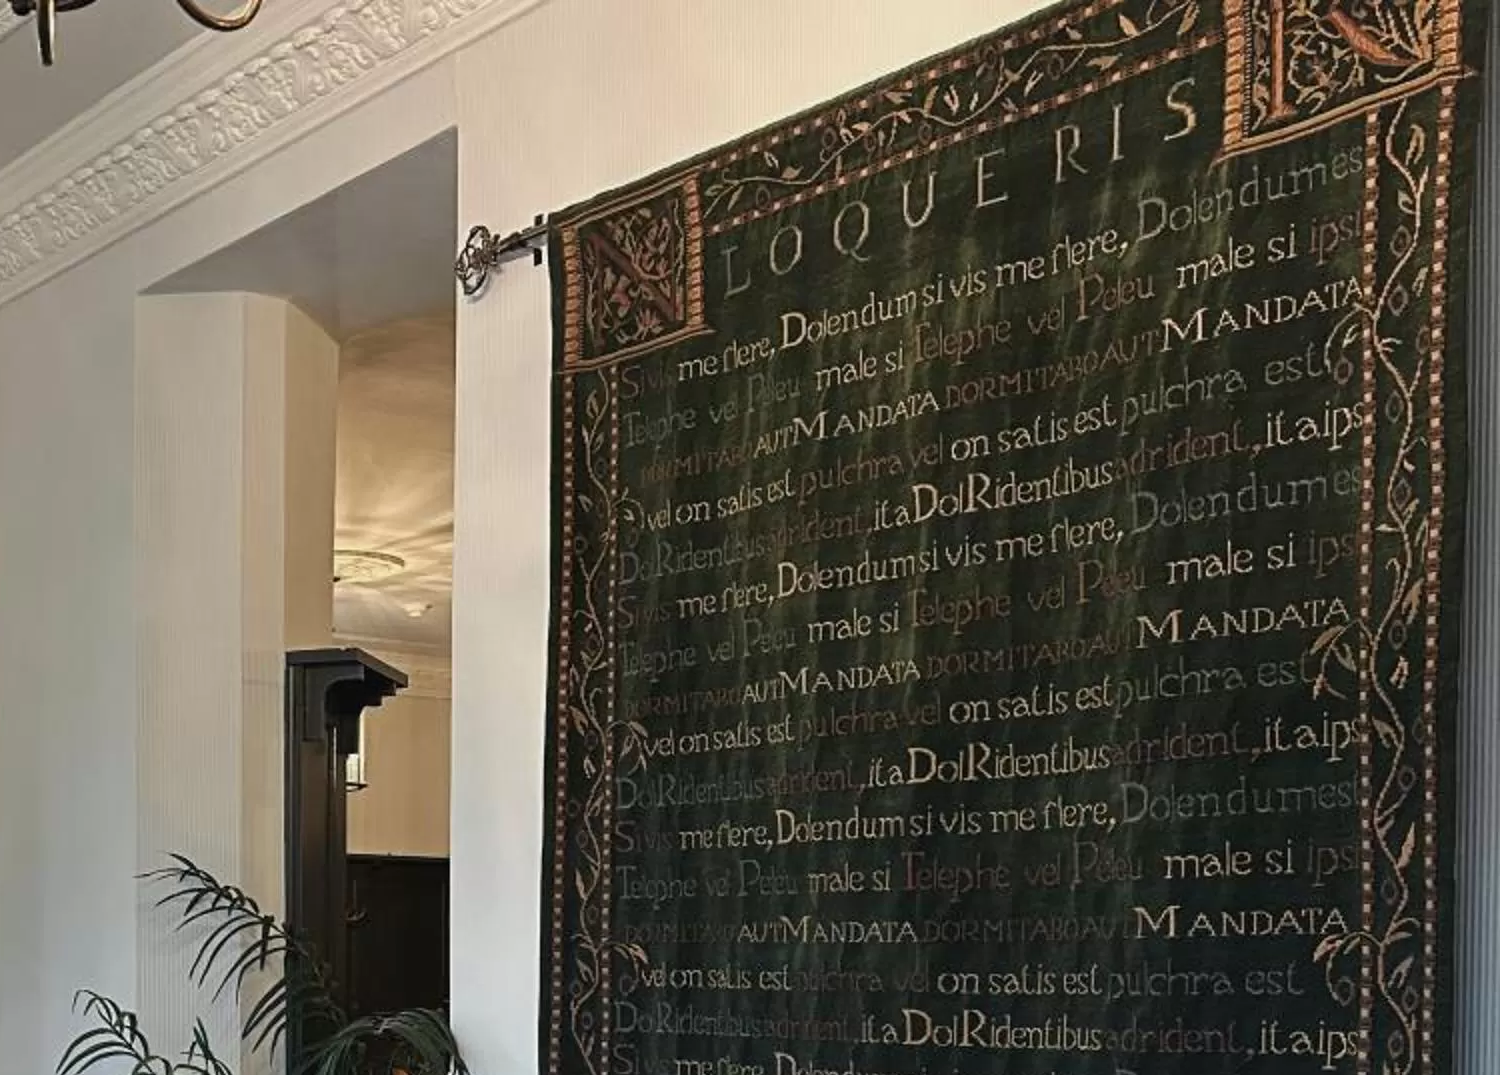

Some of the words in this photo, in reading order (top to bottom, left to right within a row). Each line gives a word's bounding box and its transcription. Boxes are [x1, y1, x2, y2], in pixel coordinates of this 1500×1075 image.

[719, 75, 1198, 300] LOQUERIS
[677, 354, 718, 383] me
[995, 255, 1046, 288] me
[815, 349, 877, 393] male
[884, 339, 905, 374] si
[1027, 295, 1066, 335] vel
[1176, 235, 1257, 290] male
[1266, 222, 1299, 263] si
[1160, 275, 1364, 353] MANDATA
[766, 467, 797, 504] est
[950, 433, 991, 463] on
[996, 409, 1070, 455] satis
[1072, 392, 1118, 436] est
[1263, 340, 1325, 387] est
[675, 592, 717, 620] me
[944, 534, 988, 569] vis
[995, 530, 1045, 563] me
[1050, 515, 1125, 554] flere,
[807, 607, 873, 645] male
[878, 600, 900, 635] si
[1165, 537, 1254, 585] male
[1266, 530, 1297, 570] si
[1134, 596, 1351, 650] MANDATA
[766, 712, 796, 745] est
[948, 698, 991, 726] on
[996, 682, 1070, 720] satis
[1075, 672, 1115, 712] est
[678, 829, 714, 851] me
[938, 803, 984, 836] vis
[988, 803, 1037, 833] me
[1041, 793, 1118, 834] flere,
[806, 862, 866, 893] male
[871, 860, 893, 893] si
[1023, 851, 1062, 888] vel
[1162, 839, 1253, 880] male
[1264, 838, 1297, 876] si
[1131, 904, 1350, 940] MANDATA
[757, 964, 793, 992] est
[936, 970, 981, 996] on
[987, 962, 1057, 996] satis
[1062, 961, 1103, 996] est
[1244, 959, 1305, 997] est
